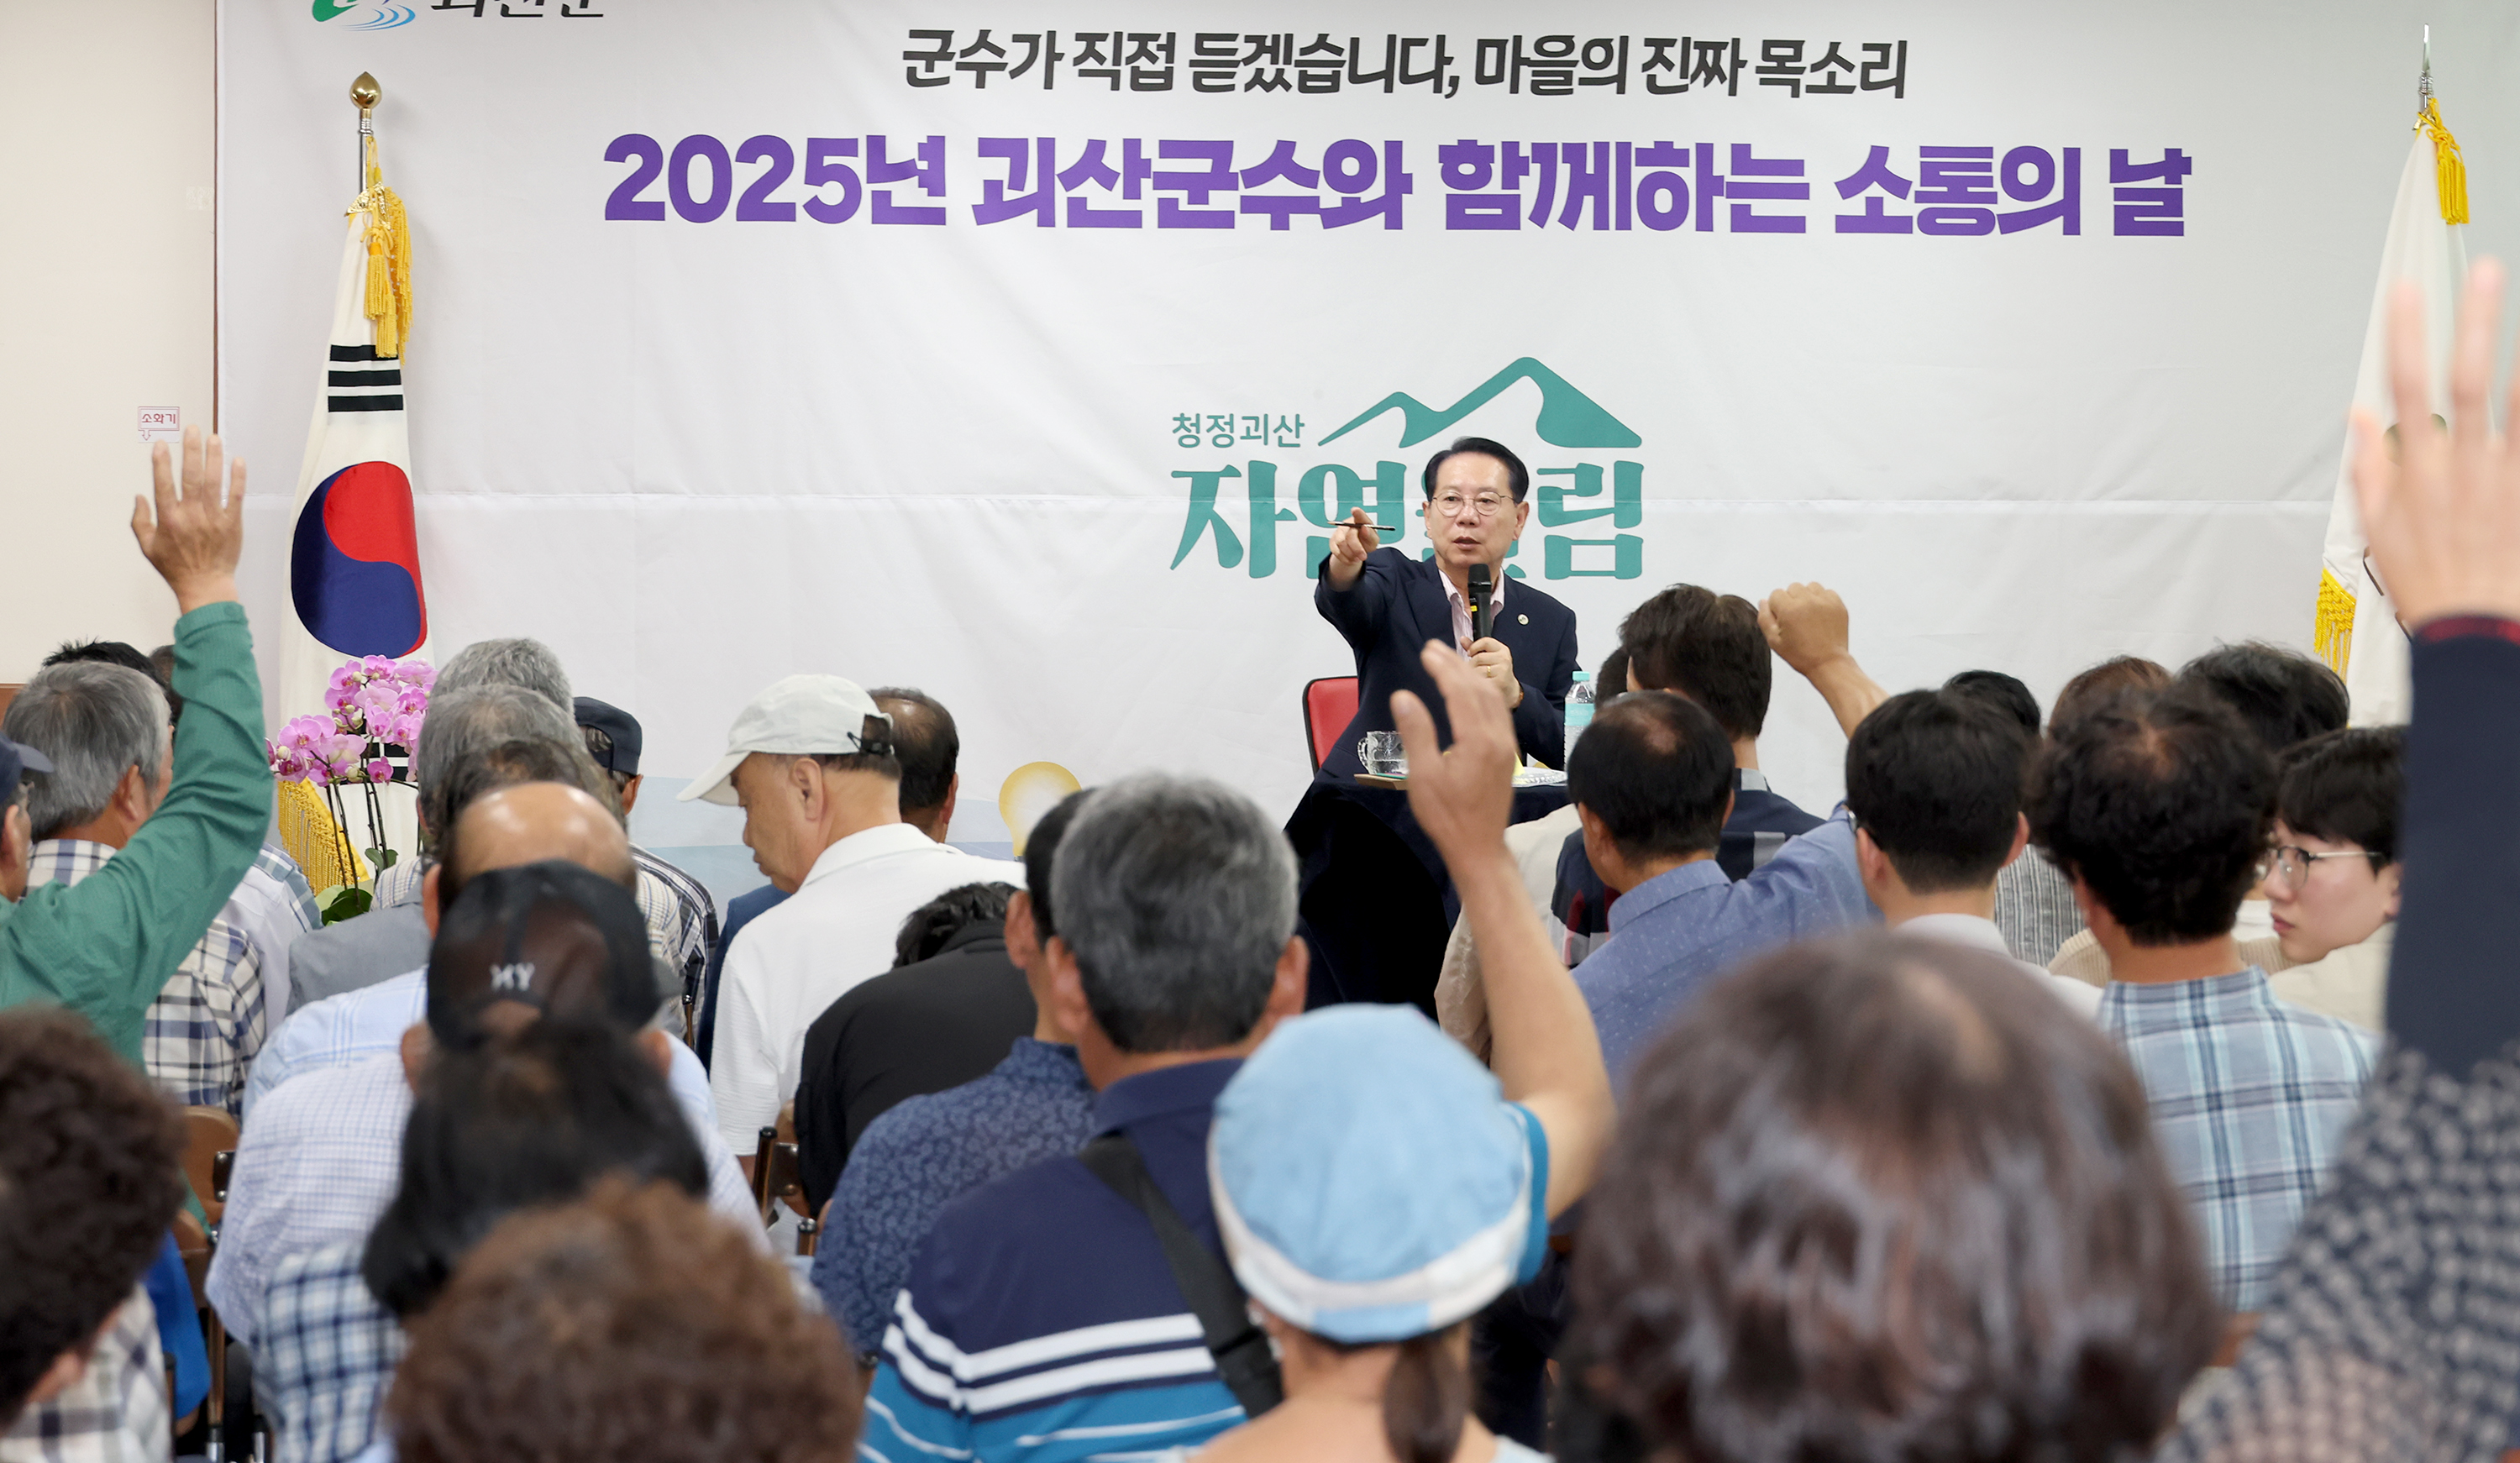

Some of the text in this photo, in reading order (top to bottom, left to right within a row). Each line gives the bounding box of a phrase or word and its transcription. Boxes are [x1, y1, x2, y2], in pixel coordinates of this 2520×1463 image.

[902, 29, 1908, 99] 군수가 직접 듣겠습니다, 마을의 진짜 목소리
[604, 134, 2192, 237] 2025년 괴산군수와 함께하는 소통의 날
[1172, 412, 1305, 448] 청정괴산
[1170, 460, 1645, 579] 자연림
